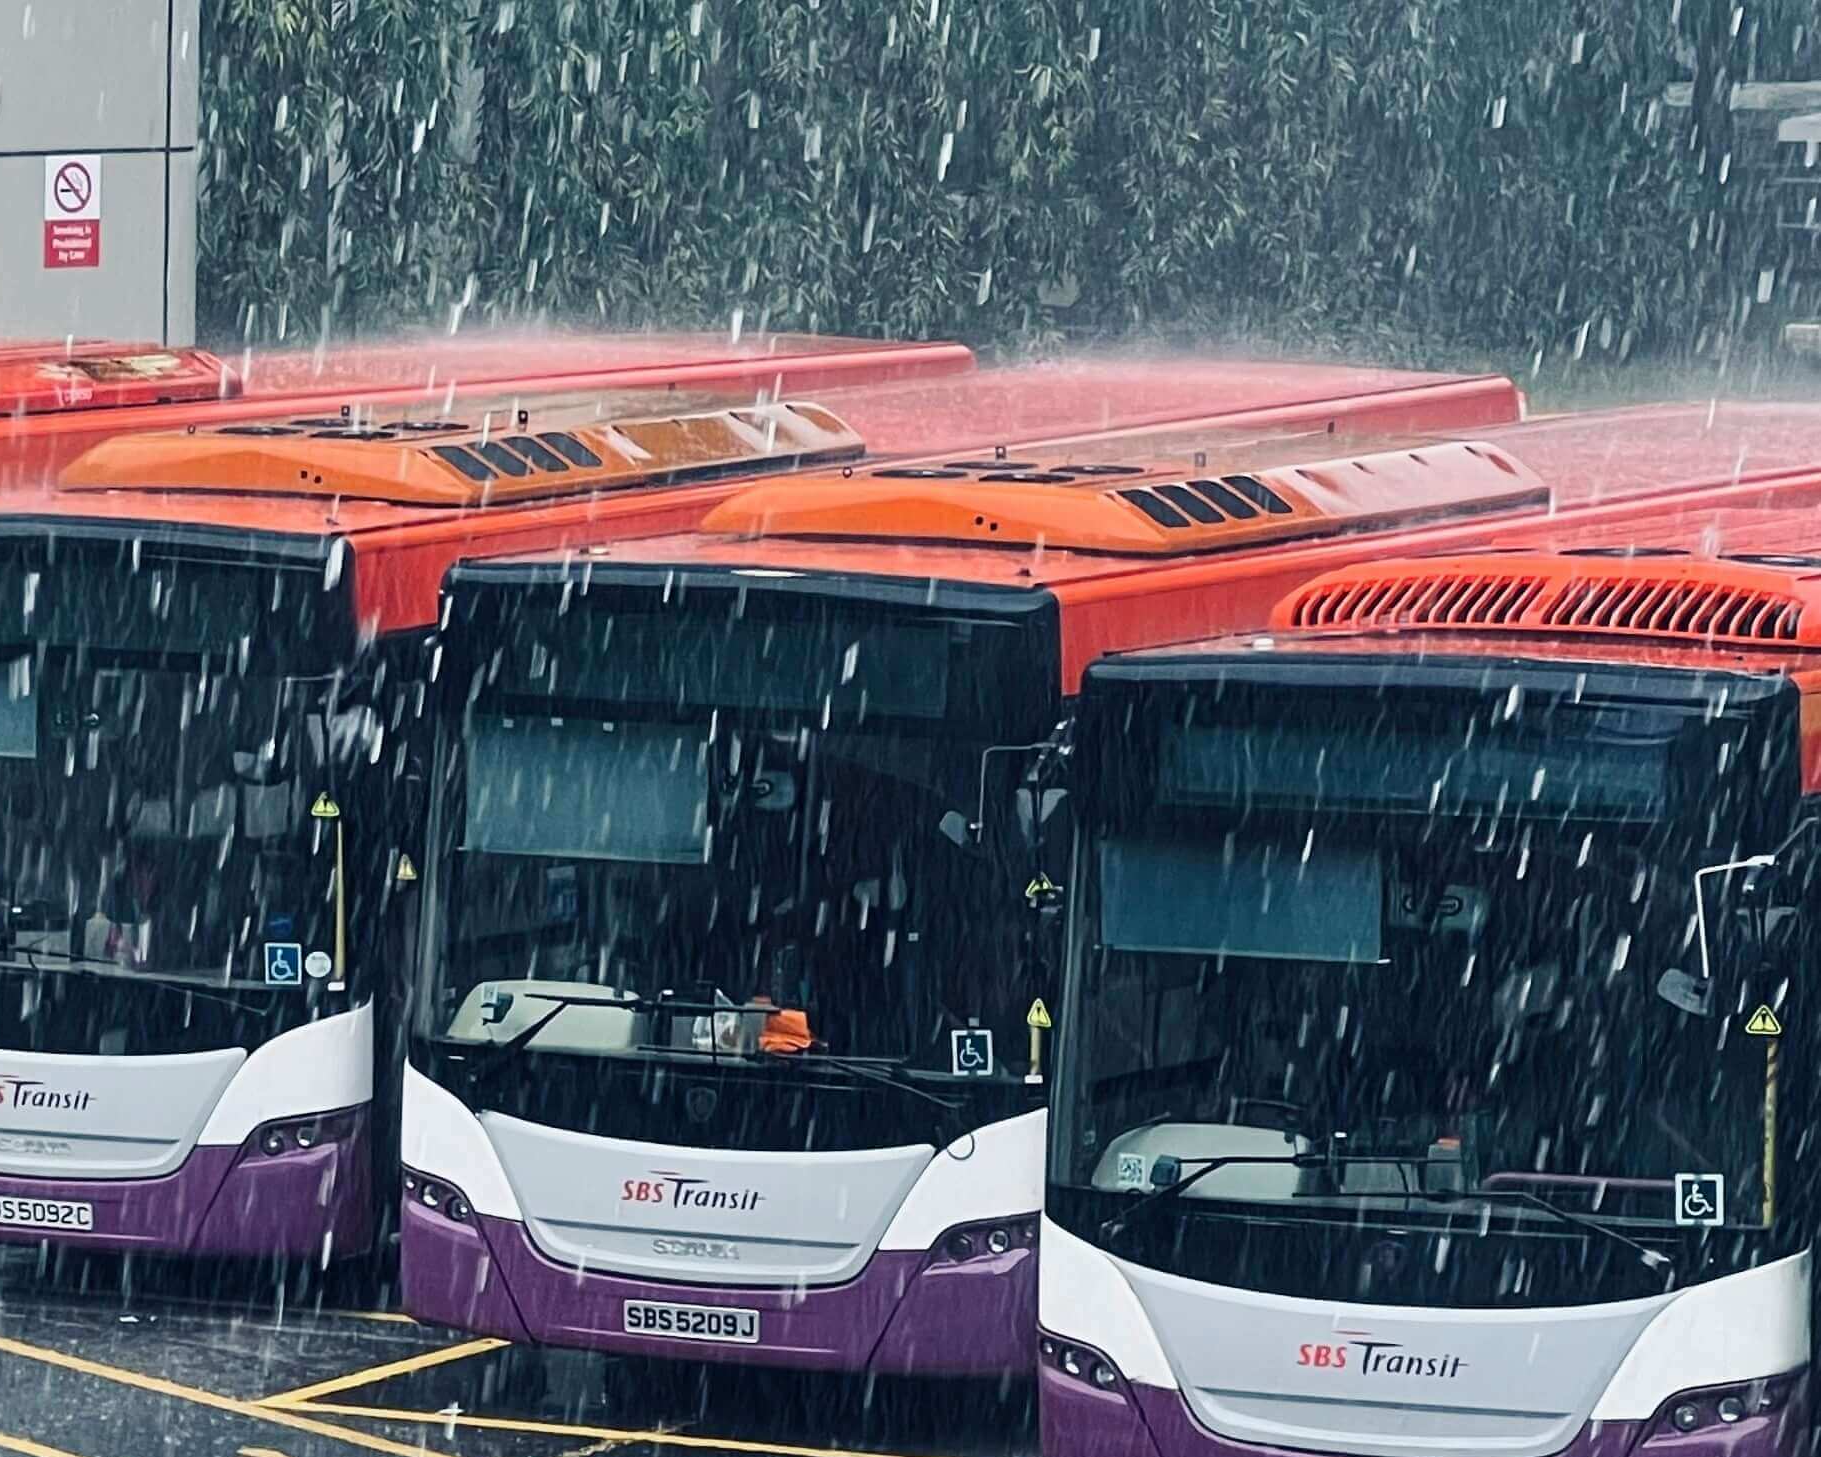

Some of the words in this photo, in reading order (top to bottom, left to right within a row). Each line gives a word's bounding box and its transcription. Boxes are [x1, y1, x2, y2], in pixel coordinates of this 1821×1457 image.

[3, 1080, 97, 1110] Transit
[621, 1180, 665, 1203] SBS
[663, 1177, 766, 1210] Transit
[1297, 1343, 1347, 1368] SBS
[1347, 1340, 1470, 1378] Transit
